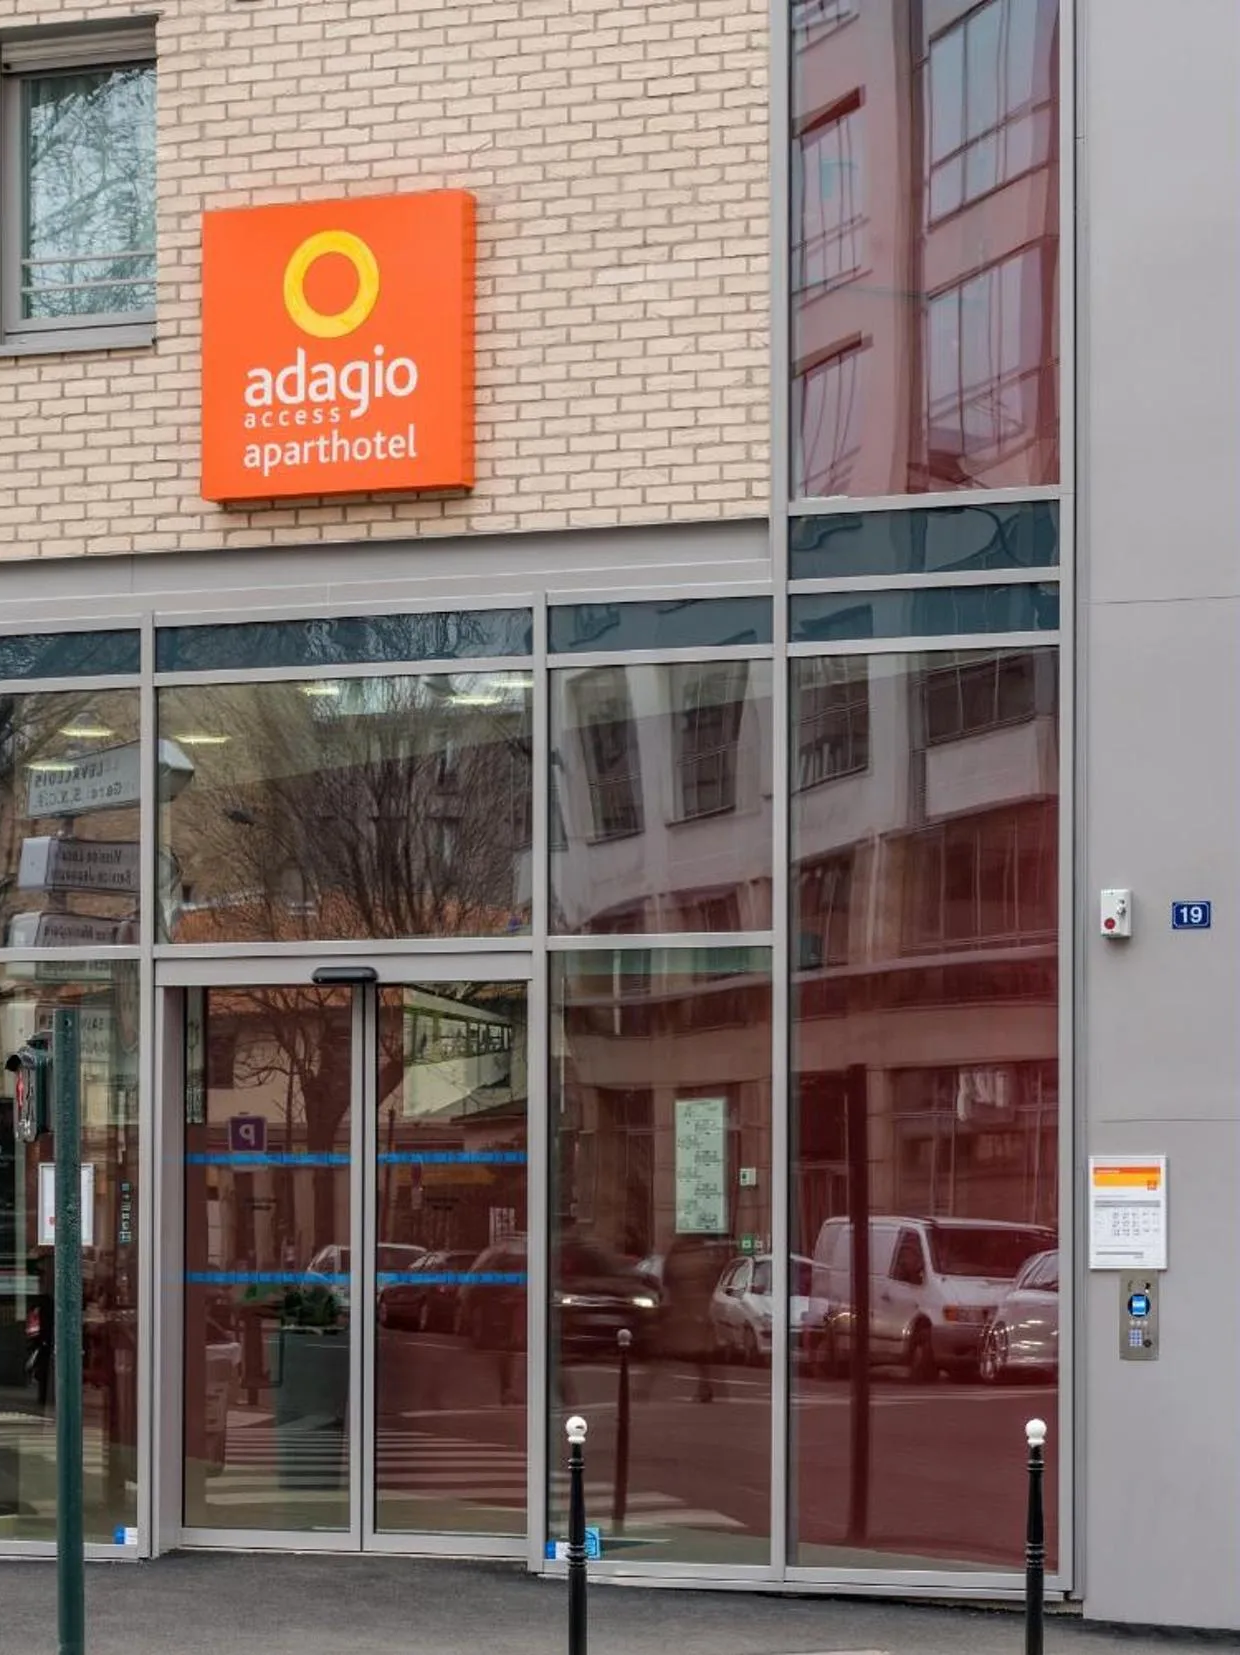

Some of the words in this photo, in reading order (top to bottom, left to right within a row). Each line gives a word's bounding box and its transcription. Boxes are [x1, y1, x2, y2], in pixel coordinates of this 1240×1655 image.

[243, 344, 418, 418] adagio
[243, 406, 341, 429] access
[242, 423, 418, 477] aparthotel
[1180, 906, 1203, 924] 19
